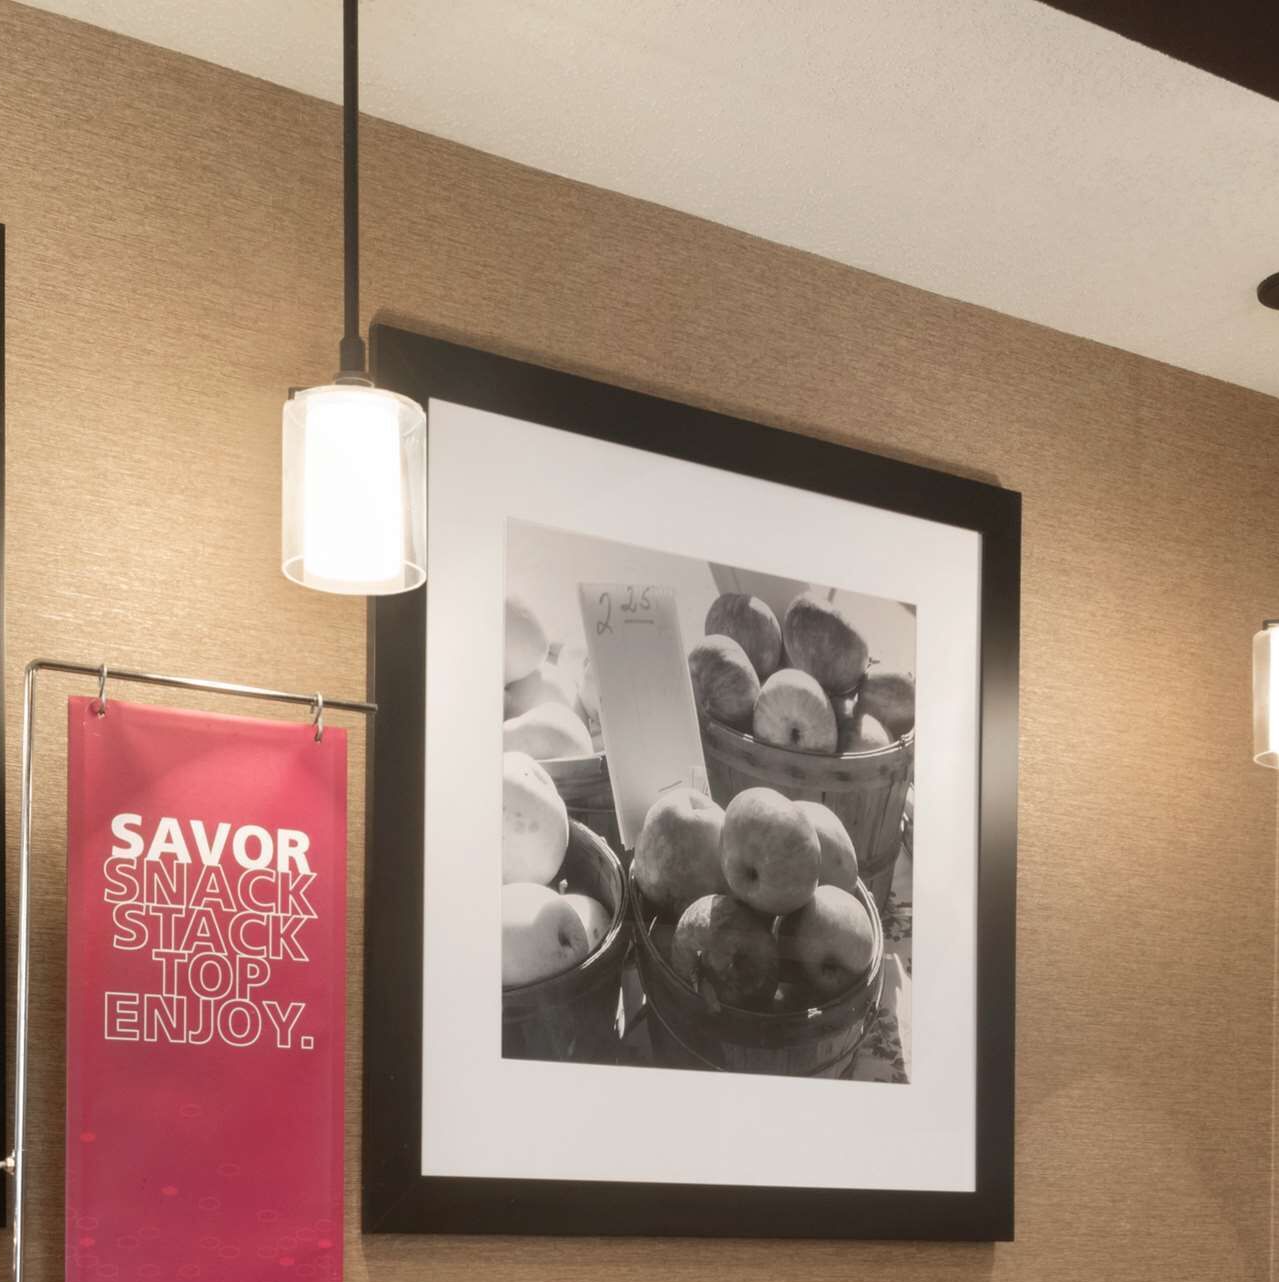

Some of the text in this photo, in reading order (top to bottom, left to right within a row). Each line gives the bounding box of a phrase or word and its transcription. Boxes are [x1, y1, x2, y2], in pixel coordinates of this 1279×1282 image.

[110, 812, 311, 876] SAVOR
[103, 855, 319, 920] SNACK
[112, 900, 310, 962] STACK
[152, 948, 271, 1002] TOP
[104, 991, 315, 1050] ENJOY.
